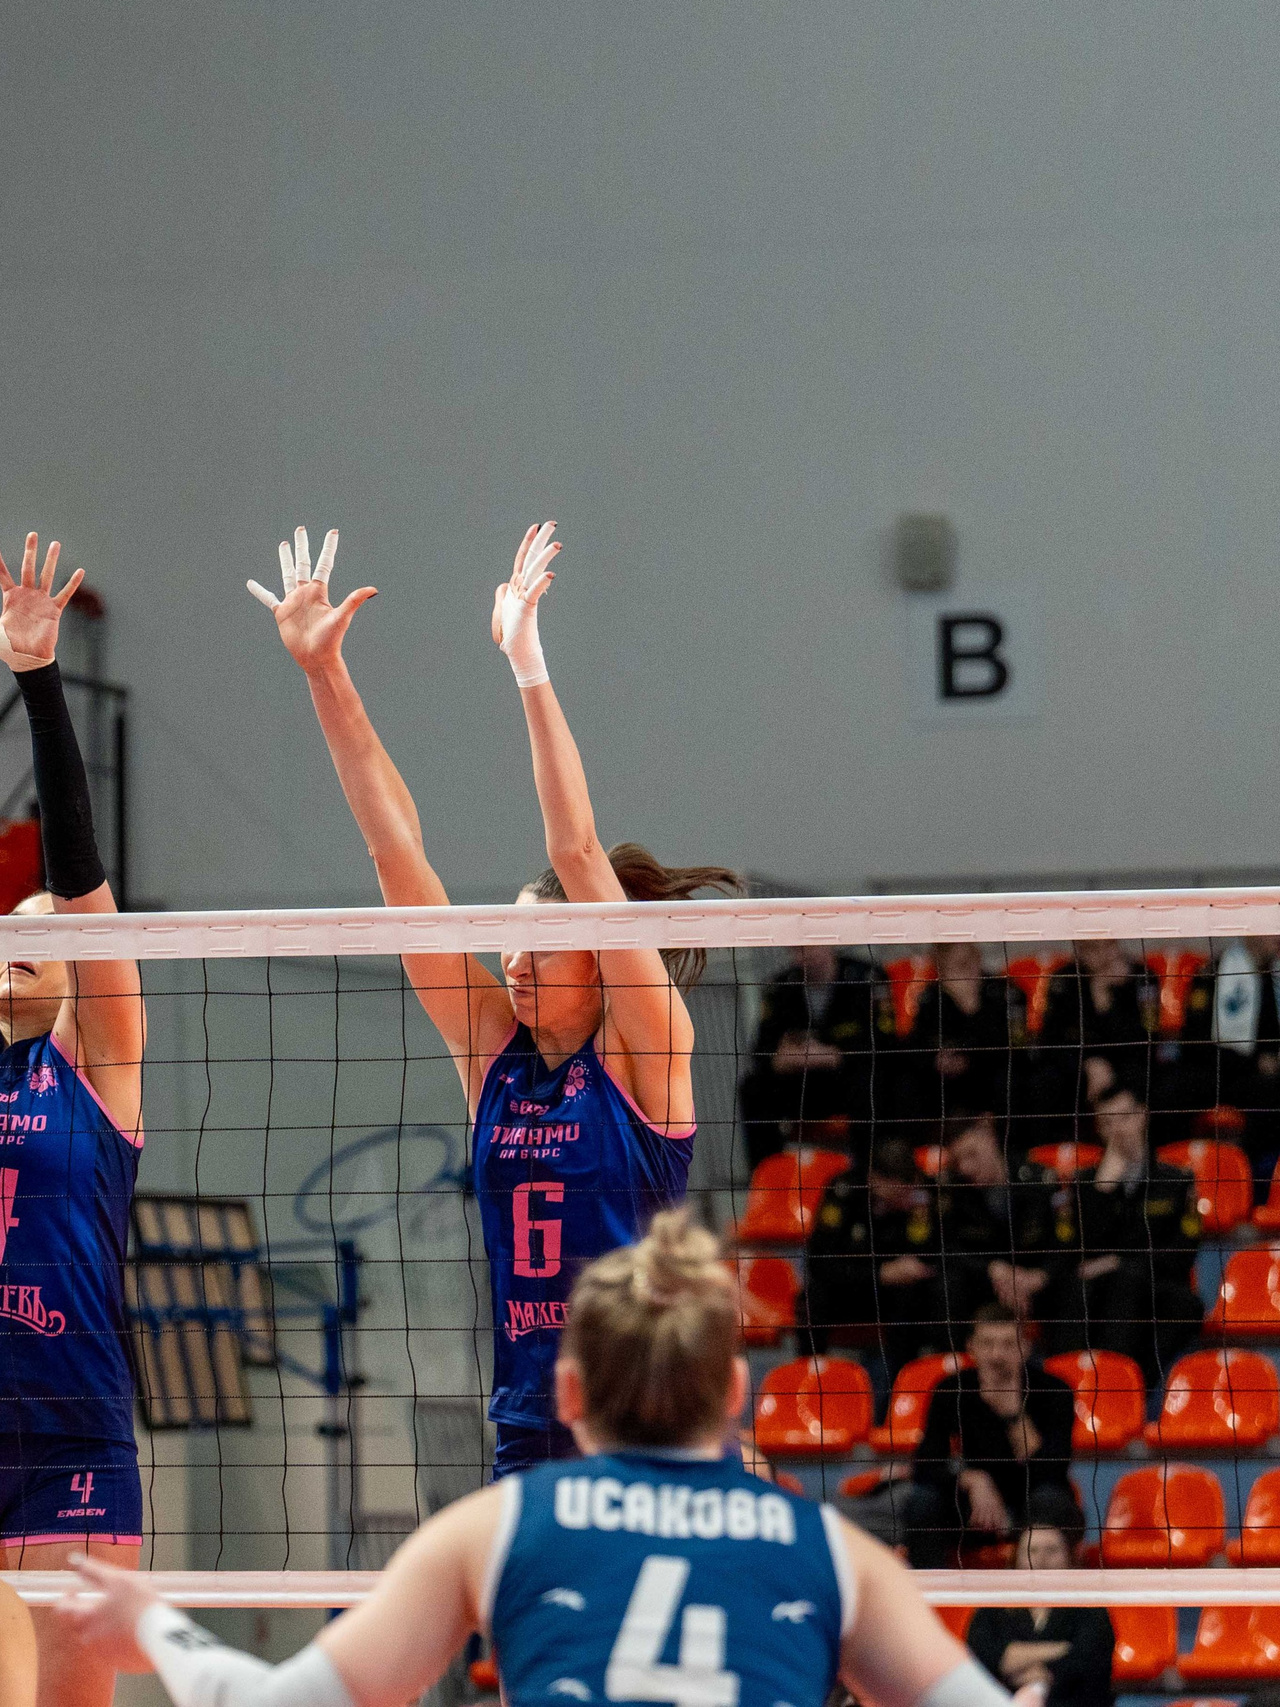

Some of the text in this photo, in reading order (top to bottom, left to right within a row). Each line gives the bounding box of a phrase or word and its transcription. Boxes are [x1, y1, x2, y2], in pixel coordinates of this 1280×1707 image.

[512, 1181, 565, 1279] 6
[57, 1508, 107, 1518] ENSEN
[70, 1471, 95, 1504] 4
[554, 1476, 798, 1546] ИСАКОВА
[605, 1554, 742, 1707] 4
